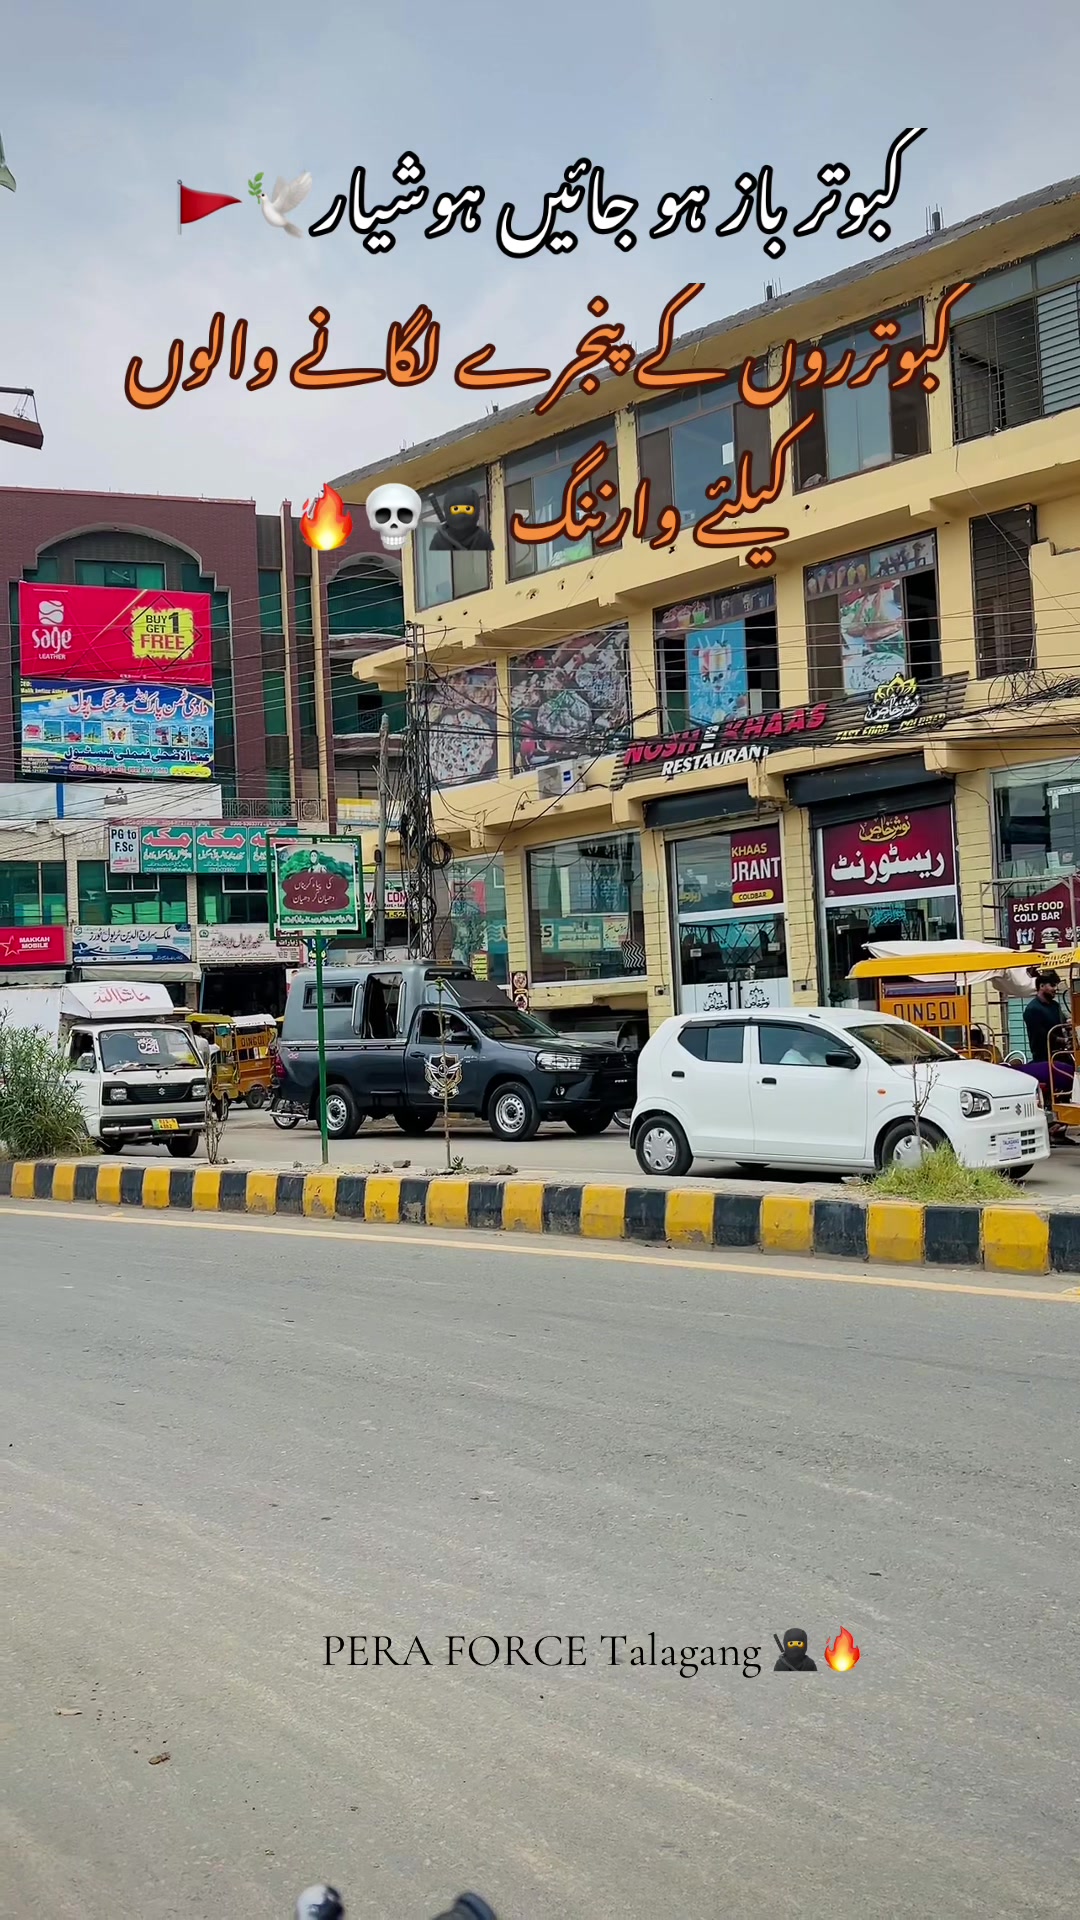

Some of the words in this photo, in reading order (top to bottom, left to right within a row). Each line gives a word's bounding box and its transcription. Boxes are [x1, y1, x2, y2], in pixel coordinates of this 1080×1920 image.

[145, 614, 167, 625] BUY
[168, 611, 180, 634] 1
[146, 624, 165, 634] GET
[31, 626, 72, 654] sage
[140, 633, 185, 651] FREE
[624, 729, 701, 766] NOSH
[722, 703, 829, 747] KHAAS
[111, 829, 124, 839] PG
[127, 829, 137, 840] to
[142, 828, 193, 849] مکہ
[197, 828, 246, 848] مکہ
[115, 841, 134, 852] F.Sc
[731, 843, 768, 857] KHAAS
[831, 843, 945, 885] ریسٹورنٹ
[738, 891, 767, 901] COLDBAR
[1013, 902, 1035, 913] FAST
[1037, 901, 1064, 912] FOOD
[1013, 912, 1038, 923] COLD
[1041, 911, 1060, 921] BAR
[19, 935, 50, 944] MAKKAH
[155, 926, 171, 940] ملک
